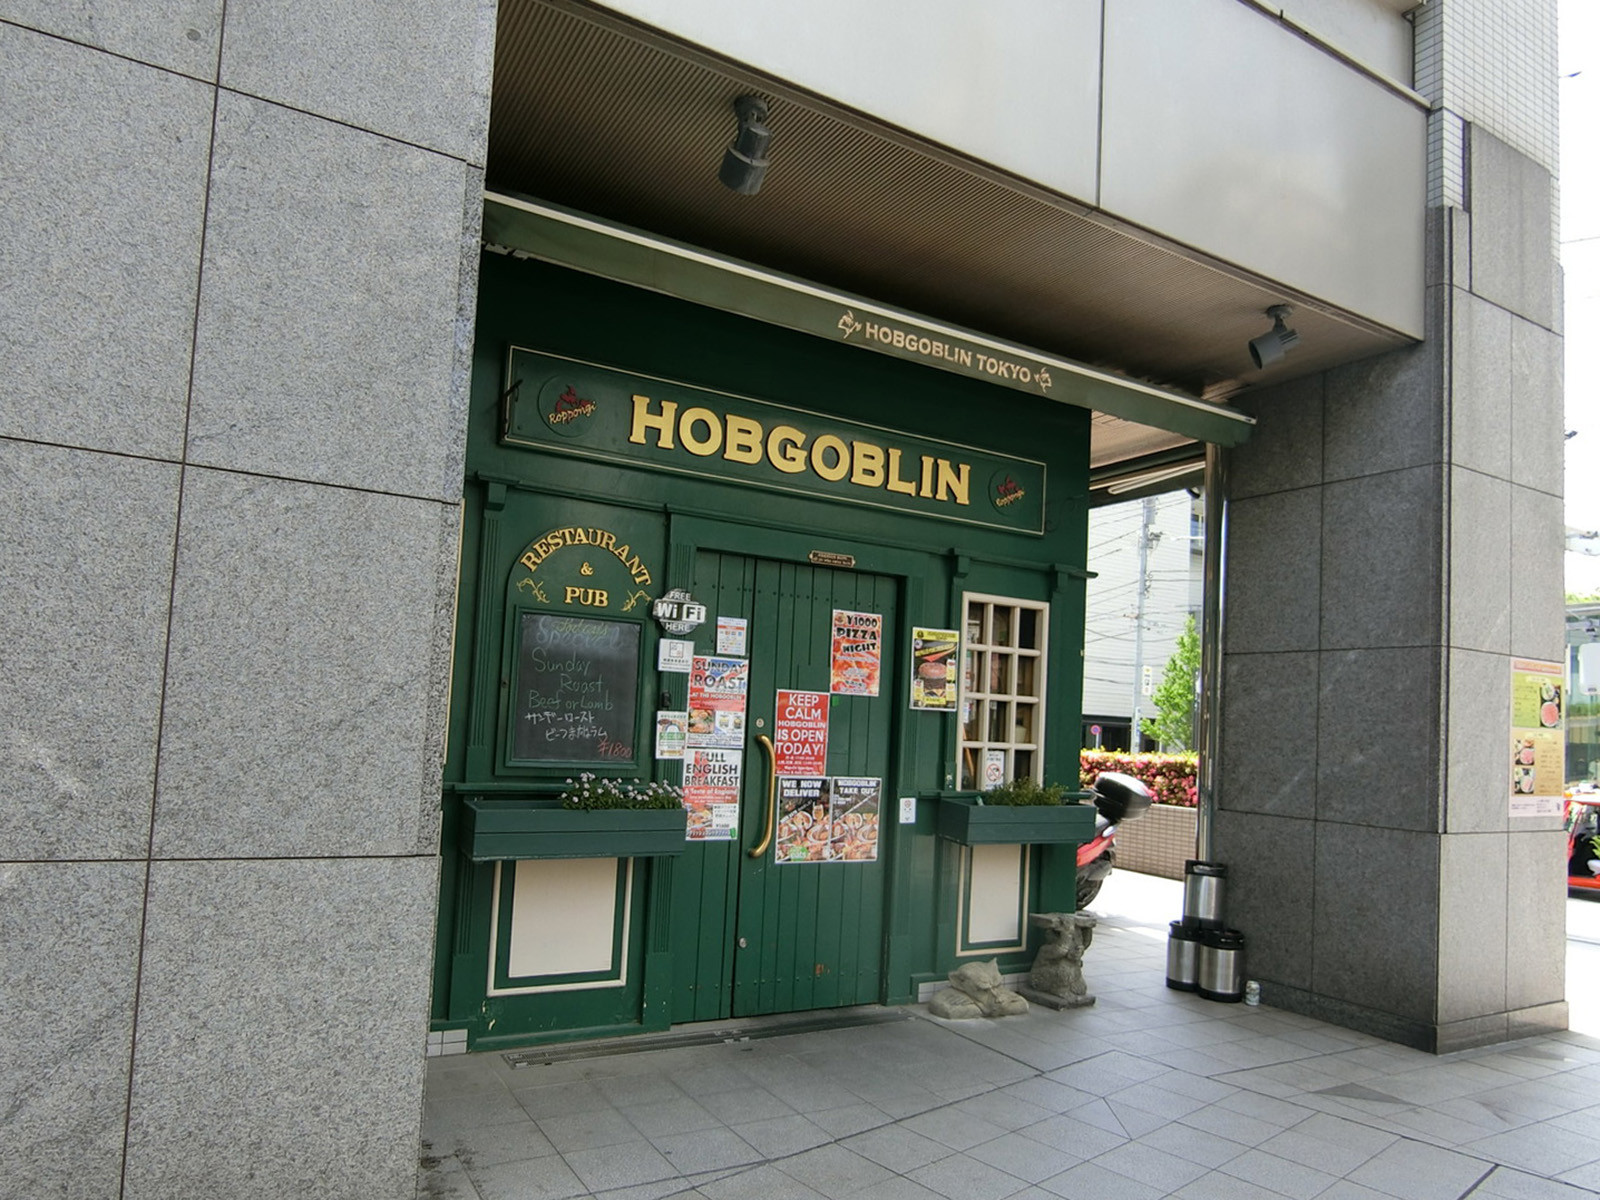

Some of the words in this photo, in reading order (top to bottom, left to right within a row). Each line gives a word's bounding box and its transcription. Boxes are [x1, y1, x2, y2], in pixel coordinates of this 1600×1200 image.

[864, 321, 972, 367] HOBGOBLIN
[976, 353, 1031, 383] TOKYO
[548, 400, 597, 425] Roppongi
[628, 394, 971, 505] HOBGOBLIN
[520, 527, 652, 586] RESTAURANT
[580, 561, 594, 576] &
[564, 586, 608, 607] PUB
[669, 590, 692, 601] FREE
[665, 621, 691, 631] HERE
[836, 627, 877, 640] PIZZA
[842, 642, 876, 653] NIGHT
[531, 646, 591, 677] Sunday
[694, 660, 746, 674] SUNDAY
[560, 673, 603, 694] Roast
[693, 674, 745, 690] ROAST
[528, 689, 566, 710] Beef
[566, 700, 579, 710] or
[789, 693, 819, 707] KEEP
[785, 706, 821, 720] CALM
[778, 720, 826, 729] HOBGOBLIN
[777, 728, 789, 741] IS
[790, 728, 824, 742] OPEN
[776, 741, 824, 756] TODAY!
[699, 751, 726, 763] FULL
[685, 763, 738, 775] ENGLISH
[684, 775, 740, 787] BREAKFAST
[782, 780, 797, 788] WE
[800, 780, 822, 788] NOW
[783, 789, 820, 798] DELIVER
[839, 787, 858, 795] TAKE
[860, 787, 875, 795] OUT
